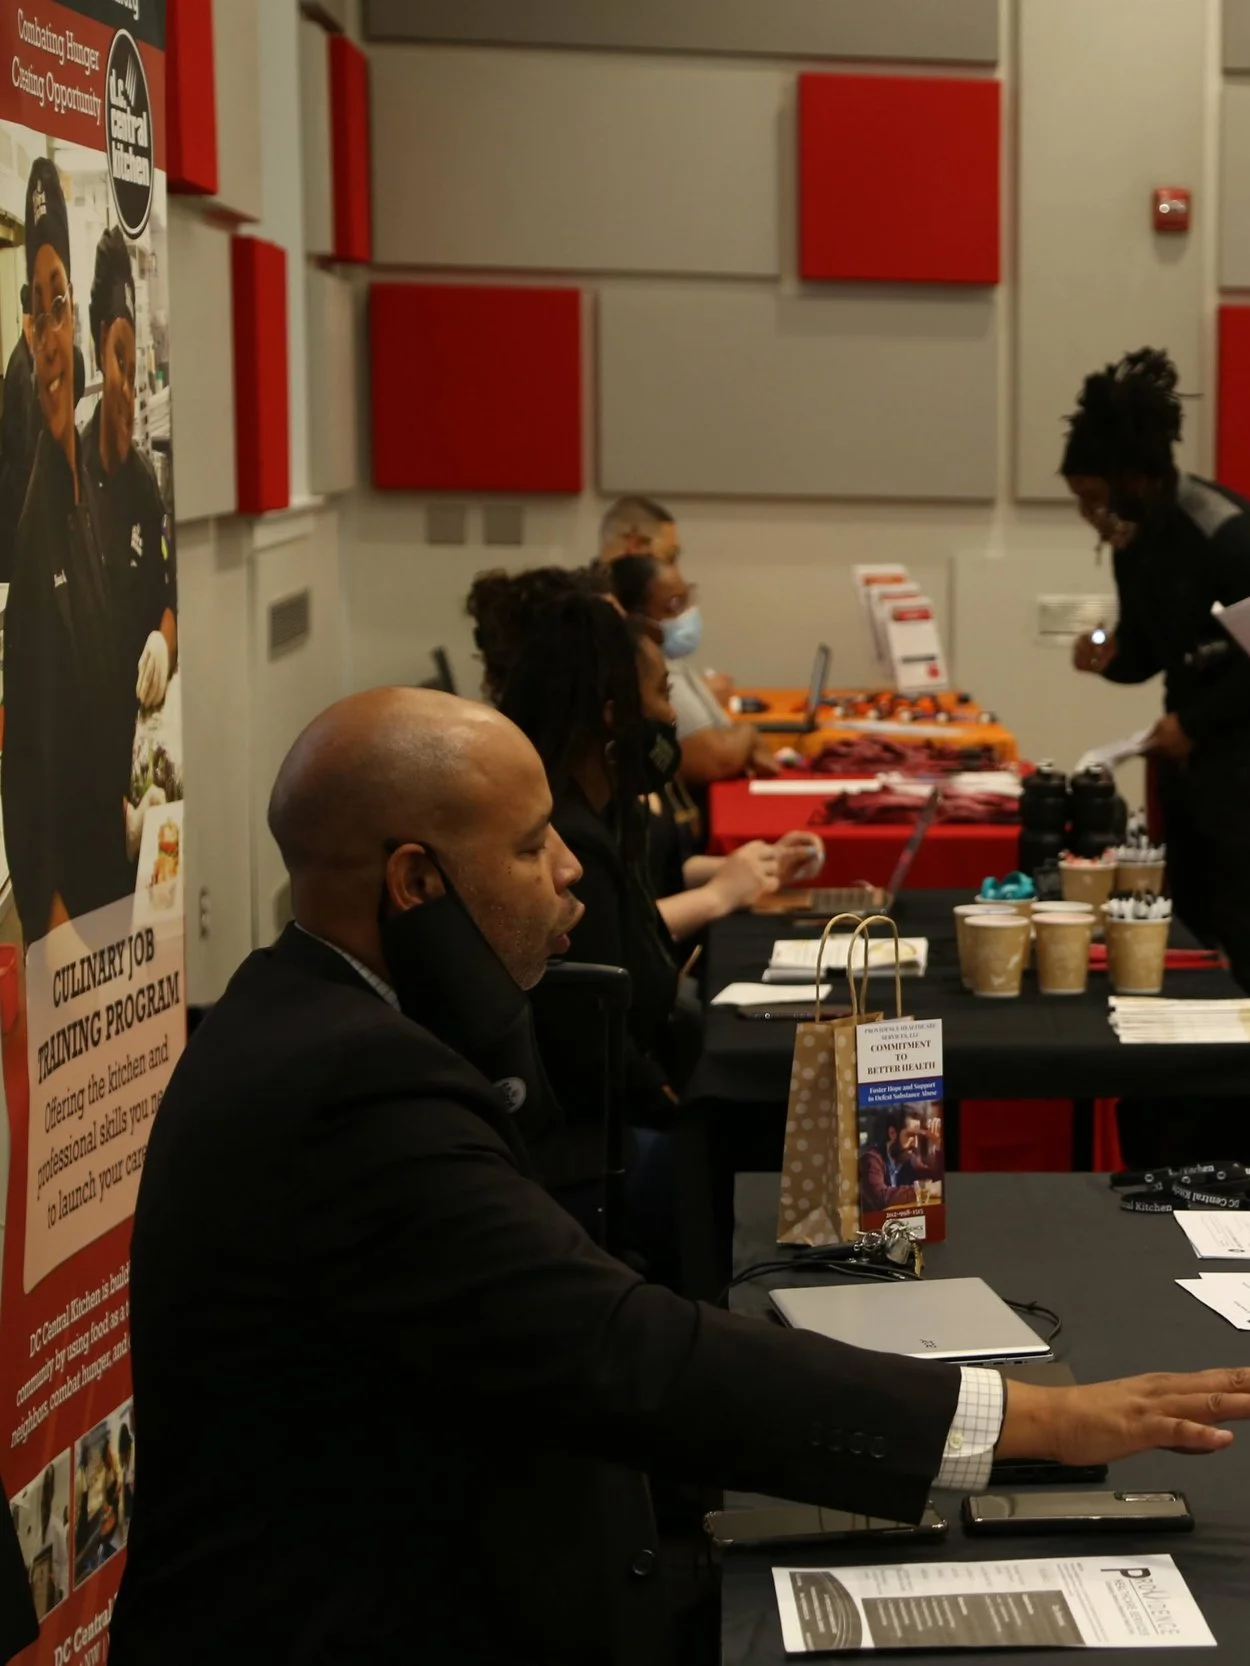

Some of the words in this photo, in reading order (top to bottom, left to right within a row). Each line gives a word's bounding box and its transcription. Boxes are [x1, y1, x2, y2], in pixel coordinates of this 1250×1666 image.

[17, 8, 65, 65] Combating
[66, 30, 100, 75] Hunger
[12, 56, 45, 107] Creating
[46, 71, 102, 126] Opportunity
[111, 106, 149, 148] central
[112, 141, 150, 187] kitchen
[53, 938, 125, 1008] CULINARY
[127, 927, 155, 981] JOB
[38, 1010, 102, 1084] TRAINING
[105, 970, 180, 1041] PROGRAM
[870, 1039, 931, 1052] COMMITMENT
[895, 1053, 908, 1061] TO
[45, 1087, 85, 1134] Offering
[88, 1071, 105, 1105] the
[107, 1054, 147, 1094] kitchen
[147, 1033, 169, 1071] and
[867, 1065, 900, 1075] BETTER
[901, 1061, 936, 1071] HEALTH
[869, 1086, 887, 1094] Foster
[887, 1085, 902, 1093] Hope
[913, 1082, 936, 1090] Support
[37, 1120, 97, 1202] professional
[99, 1105, 128, 1146] skills
[129, 1098, 149, 1136] you
[47, 1203, 57, 1230] to
[59, 1170, 97, 1221] launch
[99, 1159, 123, 1203] your
[1134, 1201, 1173, 1212] Kitchen
[1192, 1191, 1227, 1207] Central
[29, 1327, 42, 1358] DC
[42, 1304, 70, 1345] Central
[70, 1290, 102, 1324] Kitchen
[101, 1278, 110, 1300] is
[16, 1357, 54, 1408] community
[55, 1348, 67, 1373] by
[67, 1331, 90, 1362] using
[90, 1310, 110, 1345] food
[109, 1310, 119, 1331] as
[49, 1368, 81, 1411] combat
[111, 1330, 127, 1362] and
[53, 1635, 73, 1666] DC
[72, 1598, 115, 1654] Central
[1100, 1567, 1180, 1636] PROVIDENCE
